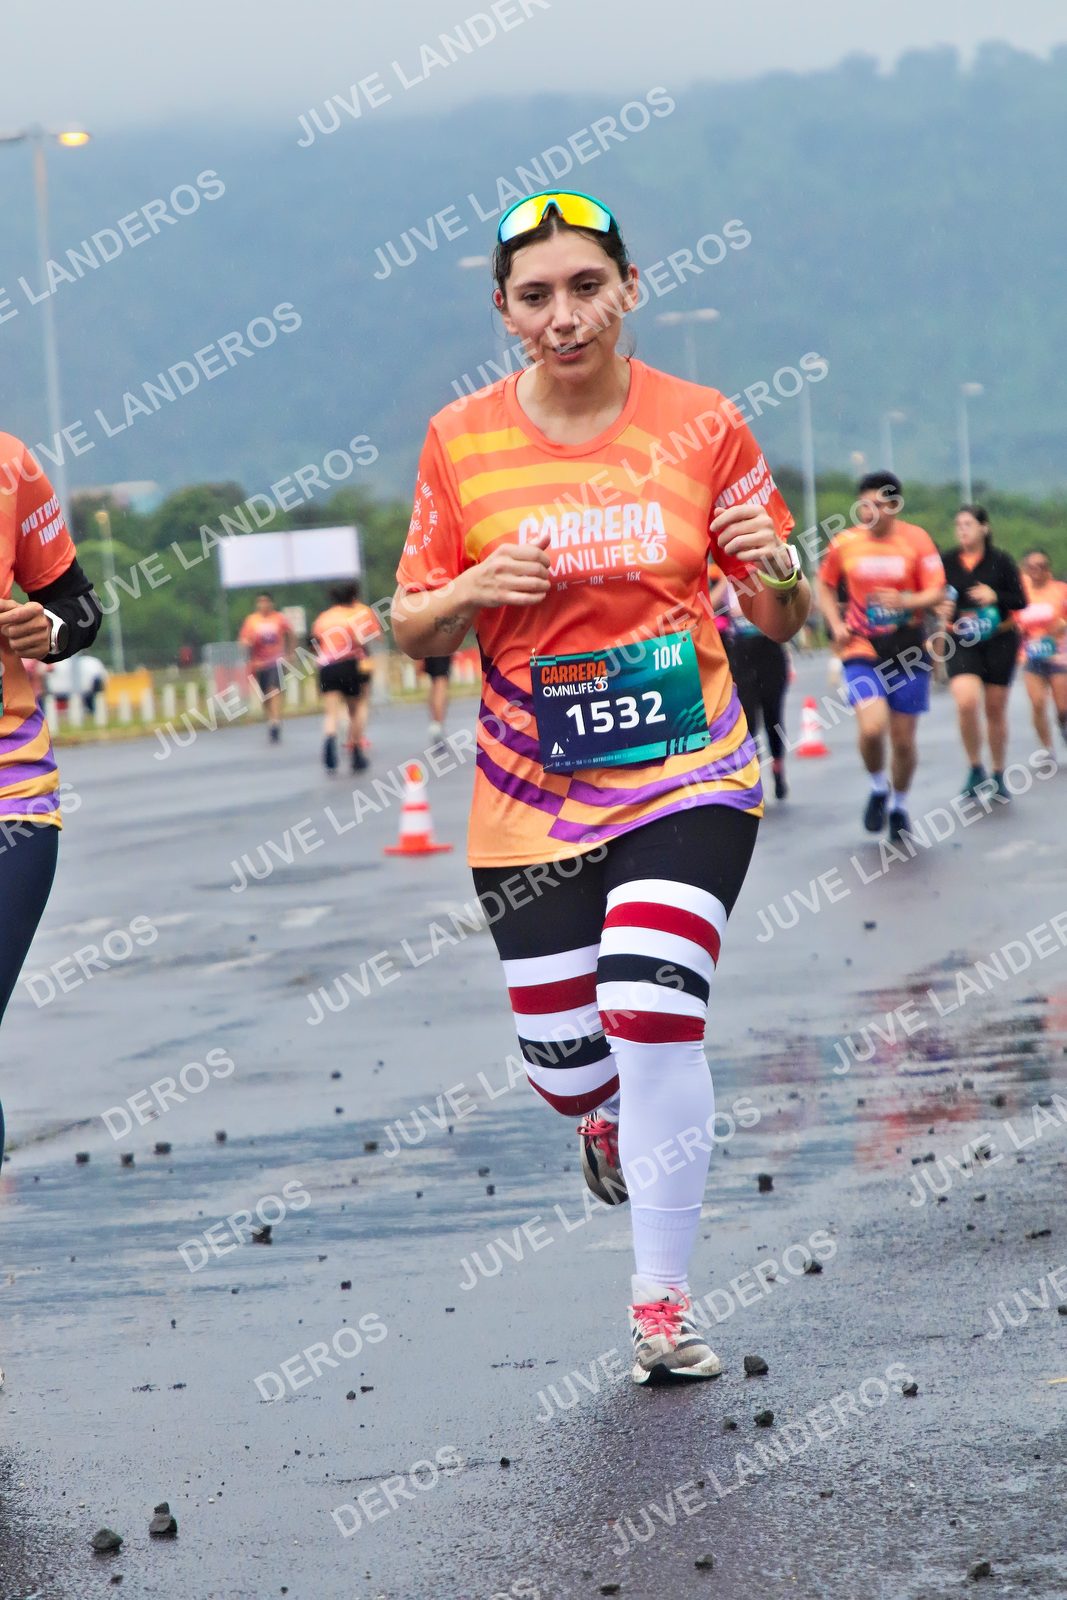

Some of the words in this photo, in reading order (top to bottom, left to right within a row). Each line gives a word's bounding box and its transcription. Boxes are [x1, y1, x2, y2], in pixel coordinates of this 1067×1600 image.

[518, 501, 666, 549] CARRERA
[550, 544, 637, 577] MNILIFE
[589, 575, 604, 585] 10K
[652, 642, 683, 671] 10K
[541, 660, 608, 685] CARRERA
[543, 682, 594, 698] OMNILIFE
[566, 690, 667, 736] 1532
